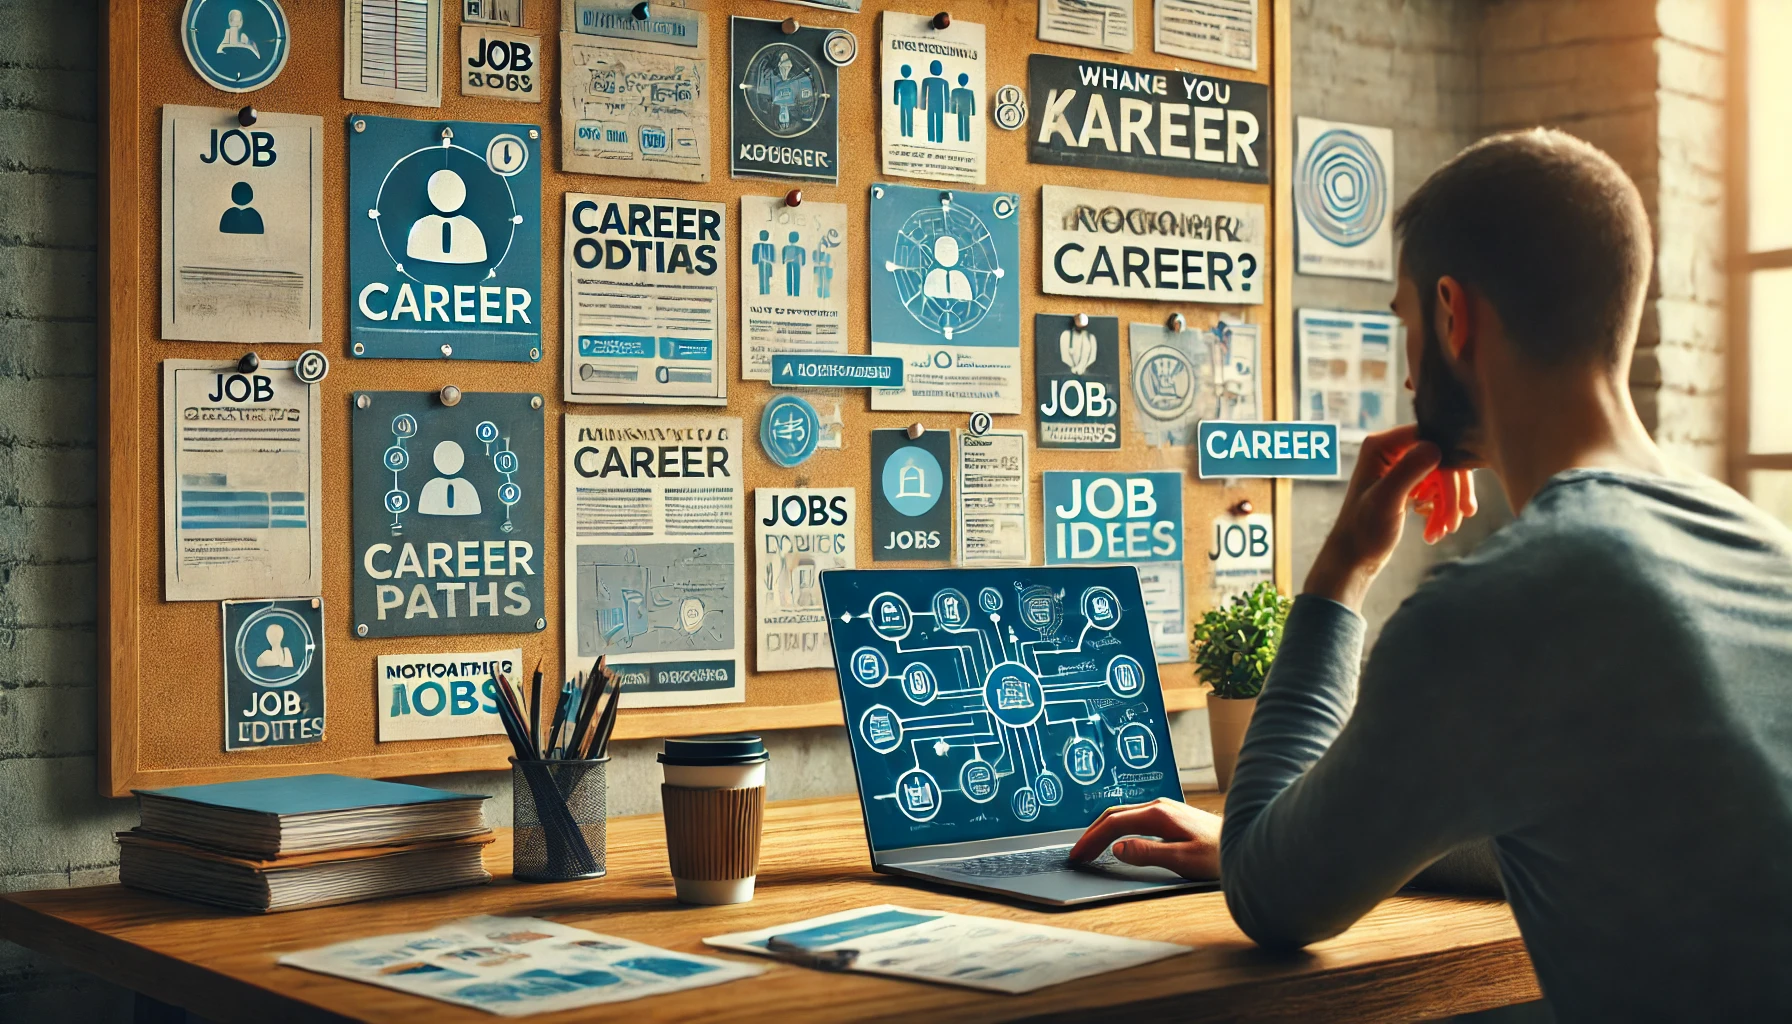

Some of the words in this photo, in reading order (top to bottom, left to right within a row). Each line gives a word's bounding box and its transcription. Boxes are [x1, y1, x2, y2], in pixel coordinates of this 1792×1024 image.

[468, 38, 533, 71] JOB
[1182, 76, 1231, 104] YOU
[1038, 88, 1260, 167] KAREER
[200, 128, 277, 167] JOB
[572, 200, 721, 241] CAREER
[573, 237, 718, 276] ODTIAS
[1053, 242, 1258, 292] CAREER?
[358, 282, 532, 325] CAREER
[208, 373, 275, 403] JOB
[573, 445, 731, 478] CAREER
[1205, 430, 1331, 460] CAREER
[762, 495, 848, 527] JOBS
[1055, 477, 1157, 519] JOB
[1056, 520, 1177, 559] IDEES
[1208, 524, 1269, 561] JOB
[363, 540, 536, 580] CAREER
[376, 581, 532, 621] PATHS
